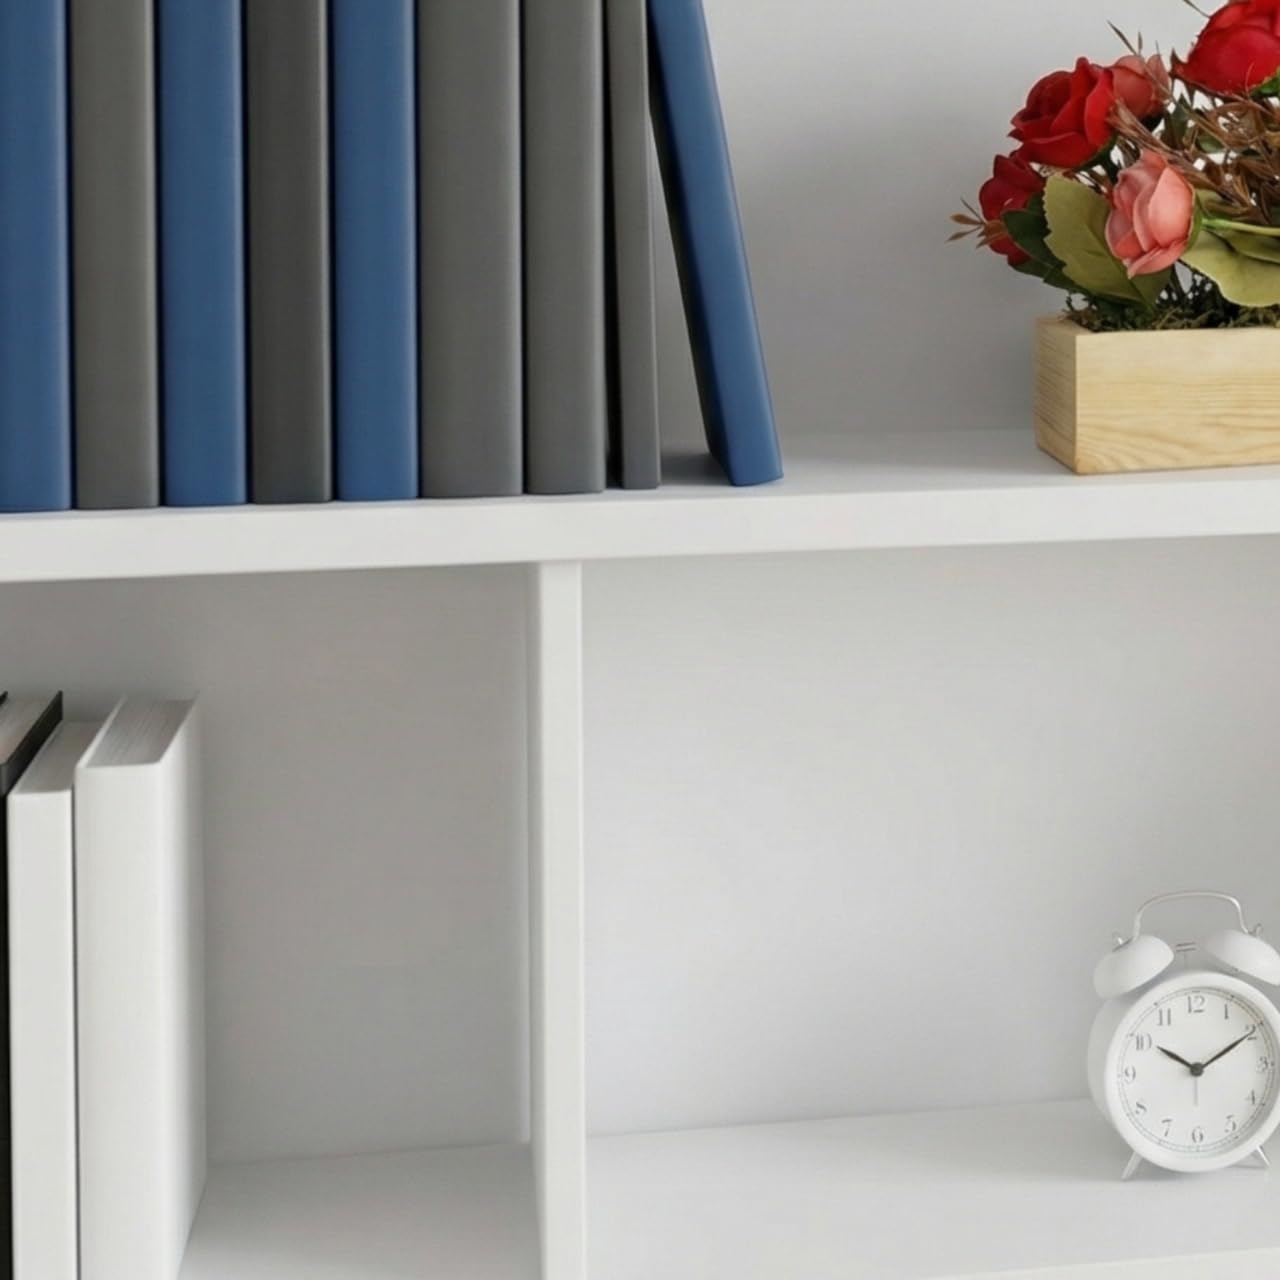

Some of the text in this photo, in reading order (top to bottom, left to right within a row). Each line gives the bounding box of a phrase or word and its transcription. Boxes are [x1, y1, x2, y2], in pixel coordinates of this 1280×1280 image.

[1187, 995, 1205, 1013] 12
[1223, 1003, 1229, 1020] 1
[1158, 1007, 1172, 1026] 11
[1245, 1024, 1257, 1041] 2
[1257, 1056, 1268, 1072] 3
[1124, 1065, 1136, 1083] 9
[1245, 1089, 1256, 1105] 4
[1161, 1118, 1173, 1137] 7
[1224, 1114, 1236, 1133] 5
[1191, 1125, 1204, 1143] 6
